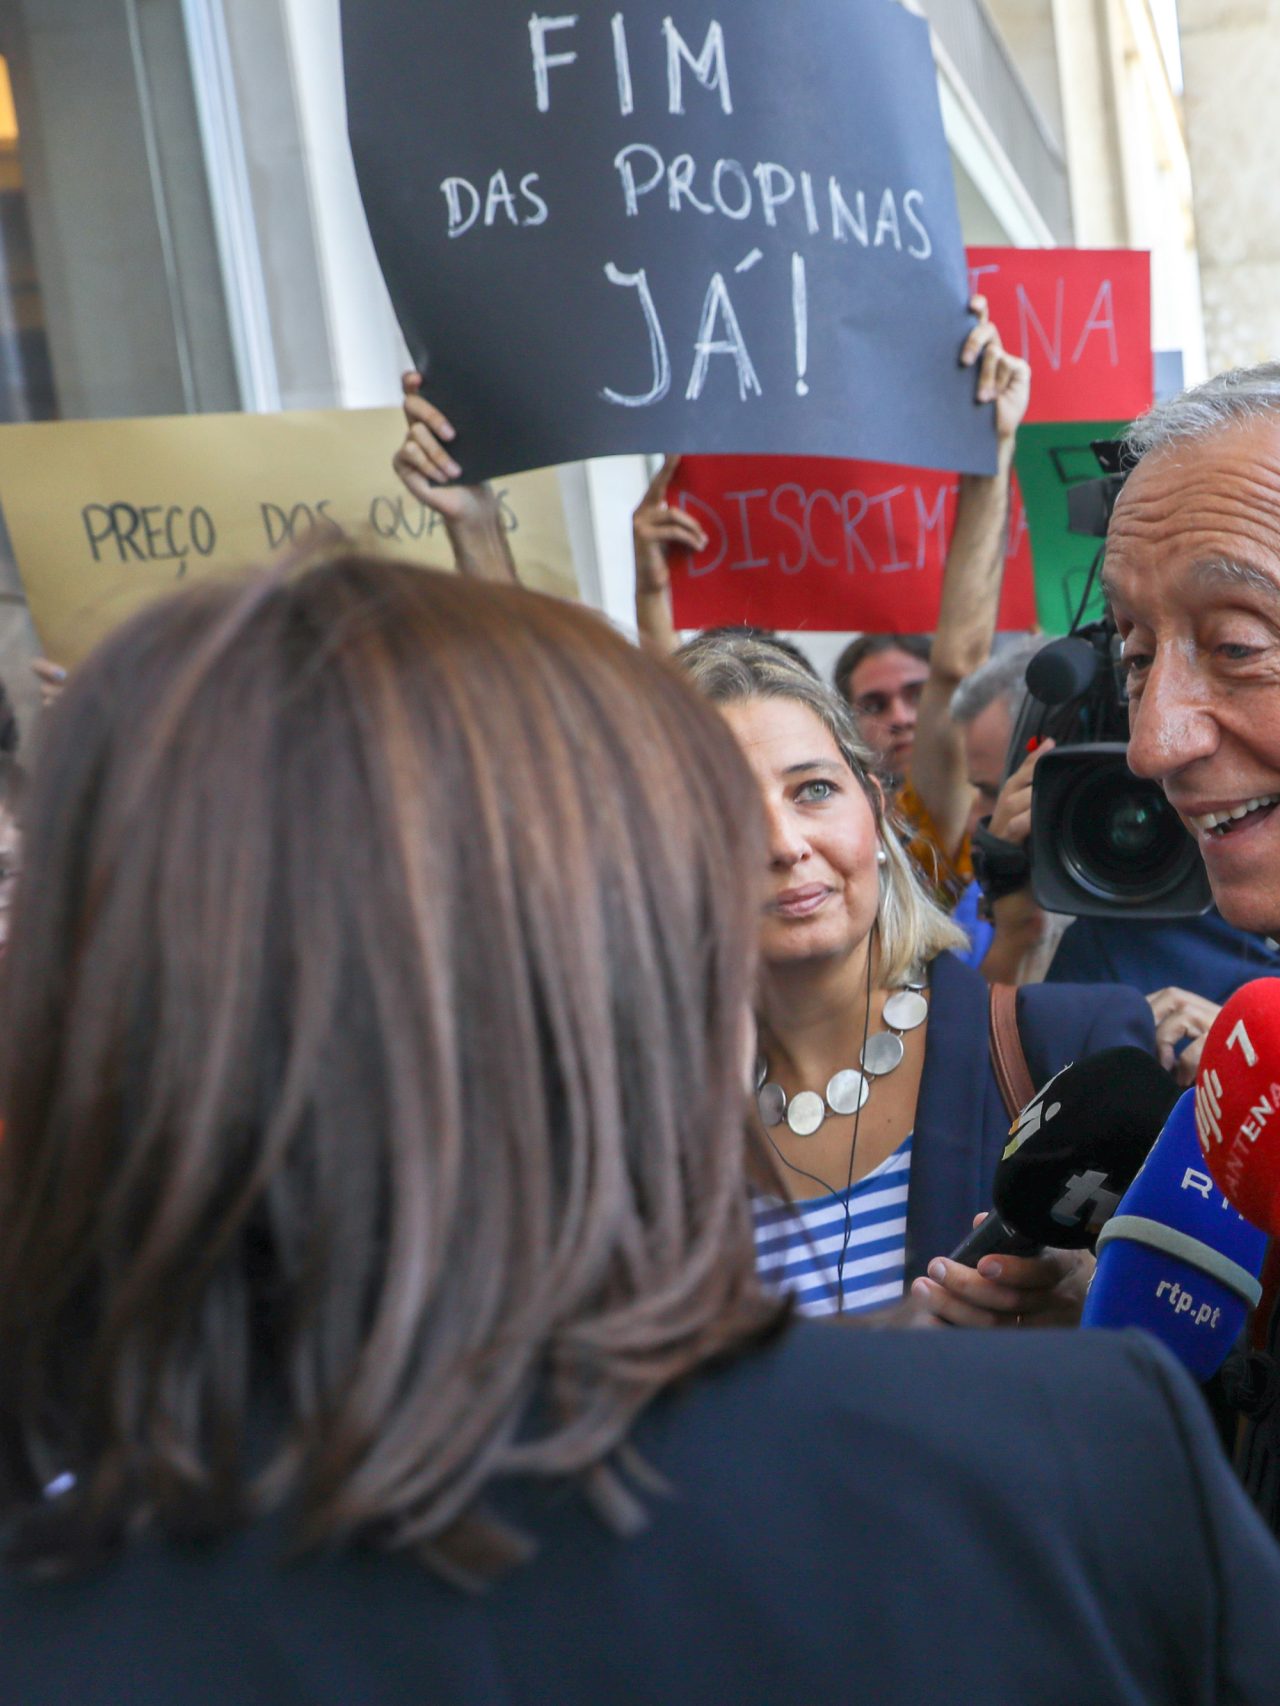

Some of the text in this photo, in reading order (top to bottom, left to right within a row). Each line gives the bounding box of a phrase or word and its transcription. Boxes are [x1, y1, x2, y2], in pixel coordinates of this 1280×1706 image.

[526, 12, 733, 115] FIM
[439, 144, 932, 260] DAS PROPINAS
[602, 248, 809, 407] JÁ!
[81, 502, 217, 581] PREÇO
[1156, 1280, 1221, 1329] rtp.pt
